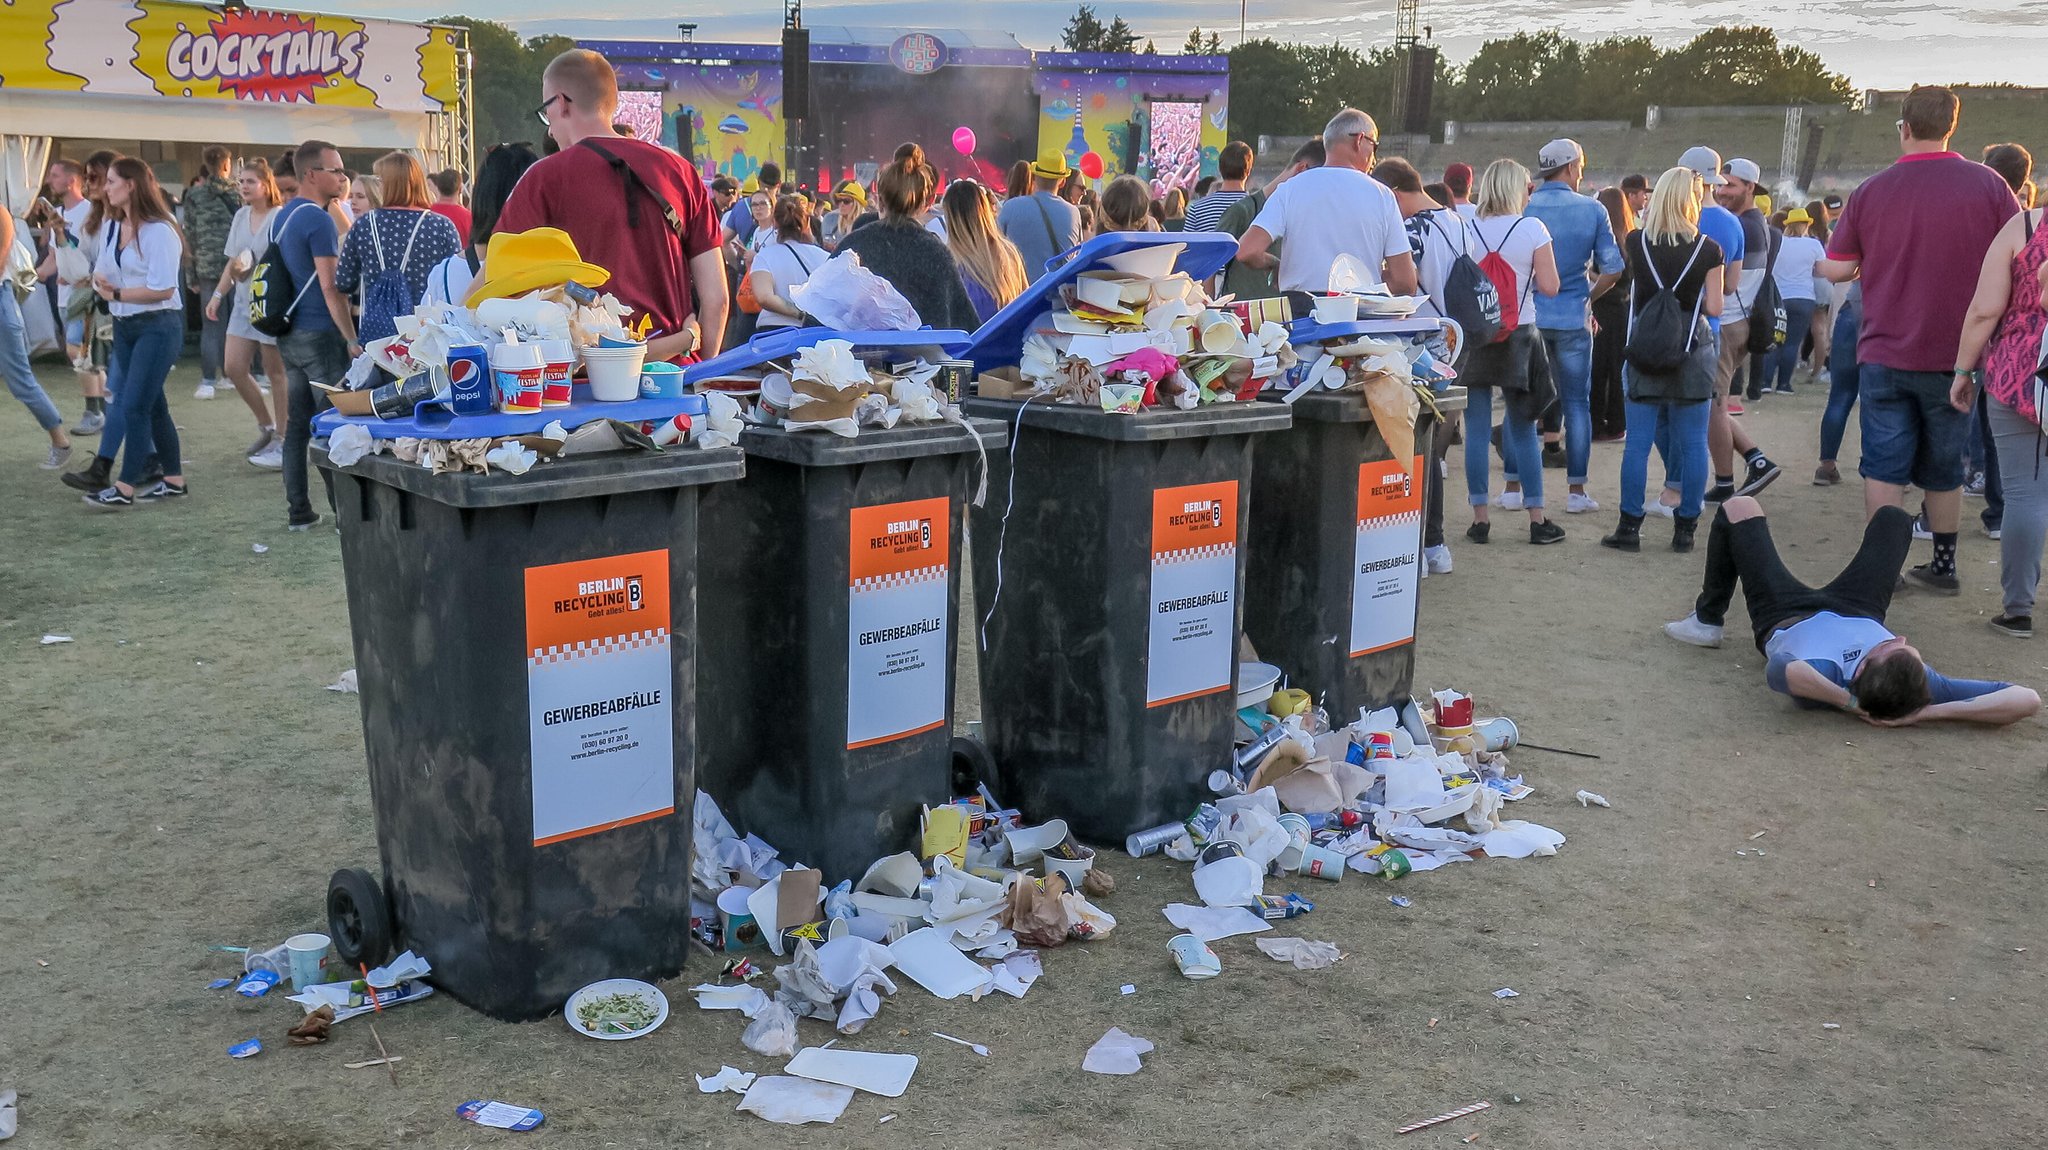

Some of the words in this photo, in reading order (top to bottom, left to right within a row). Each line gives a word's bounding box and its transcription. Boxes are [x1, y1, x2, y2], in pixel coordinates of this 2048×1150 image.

[168, 30, 364, 81] COCKTAILS
[455, 391, 480, 402] pepsi
[1169, 512, 1211, 526] RECYCLING
[1213, 506, 1220, 521] B
[1184, 501, 1211, 513] BERLIN
[870, 532, 919, 549] RECYCLING
[921, 525, 930, 541] B
[887, 520, 919, 534] BERLIN
[1361, 553, 1415, 575] GEWERBEABFÄLLE
[578, 577, 624, 596] BERLIN
[554, 592, 624, 614] RECYCLING
[629, 584, 641, 603] B
[1158, 591, 1229, 614] GEWERBEABFÄLLE
[588, 609, 604, 619] Gebt
[606, 606, 625, 617] alles!
[859, 618, 941, 646] GEWERBEABFÄLLE
[543, 690, 661, 726] GEWERBEABFÄLLE
[571, 741, 639, 760] www.berlin-recycling.de
[581, 740, 598, 750] (030)
[598, 738, 607, 746] 60
[607, 736, 616, 744] 97
[616, 735, 624, 743] 20
